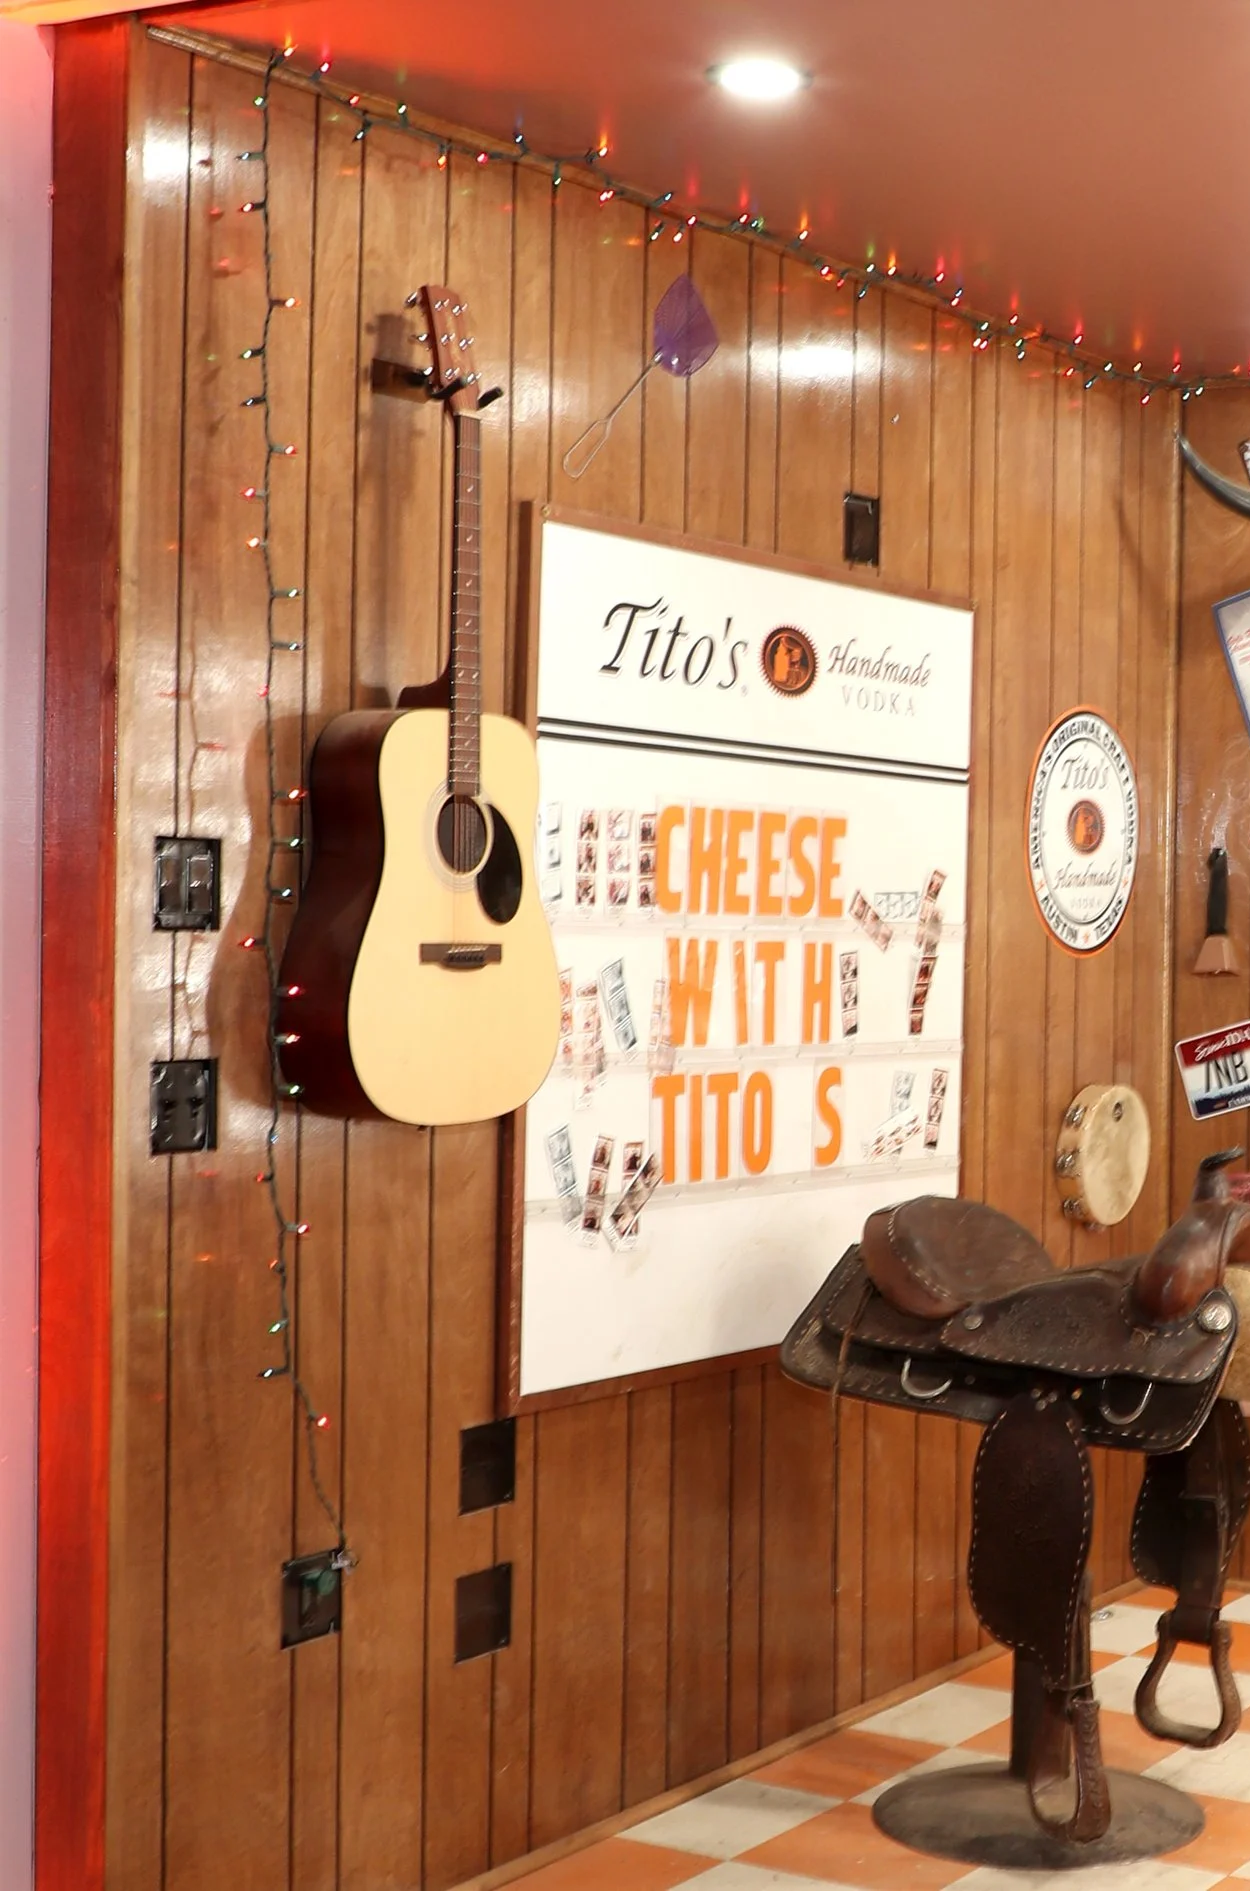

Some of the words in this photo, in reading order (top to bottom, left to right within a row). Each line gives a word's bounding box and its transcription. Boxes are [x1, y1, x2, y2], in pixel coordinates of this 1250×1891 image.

[599, 596, 749, 690] Tito's
[828, 638, 931, 688] Handmade
[841, 685, 916, 717] VODKA
[1061, 754, 1109, 791] Tito's
[656, 805, 848, 918] CHEESE
[1054, 859, 1118, 889] Handmade
[666, 937, 833, 1047] WITH
[652, 1070, 774, 1185] TITO
[815, 1066, 843, 1168] S
